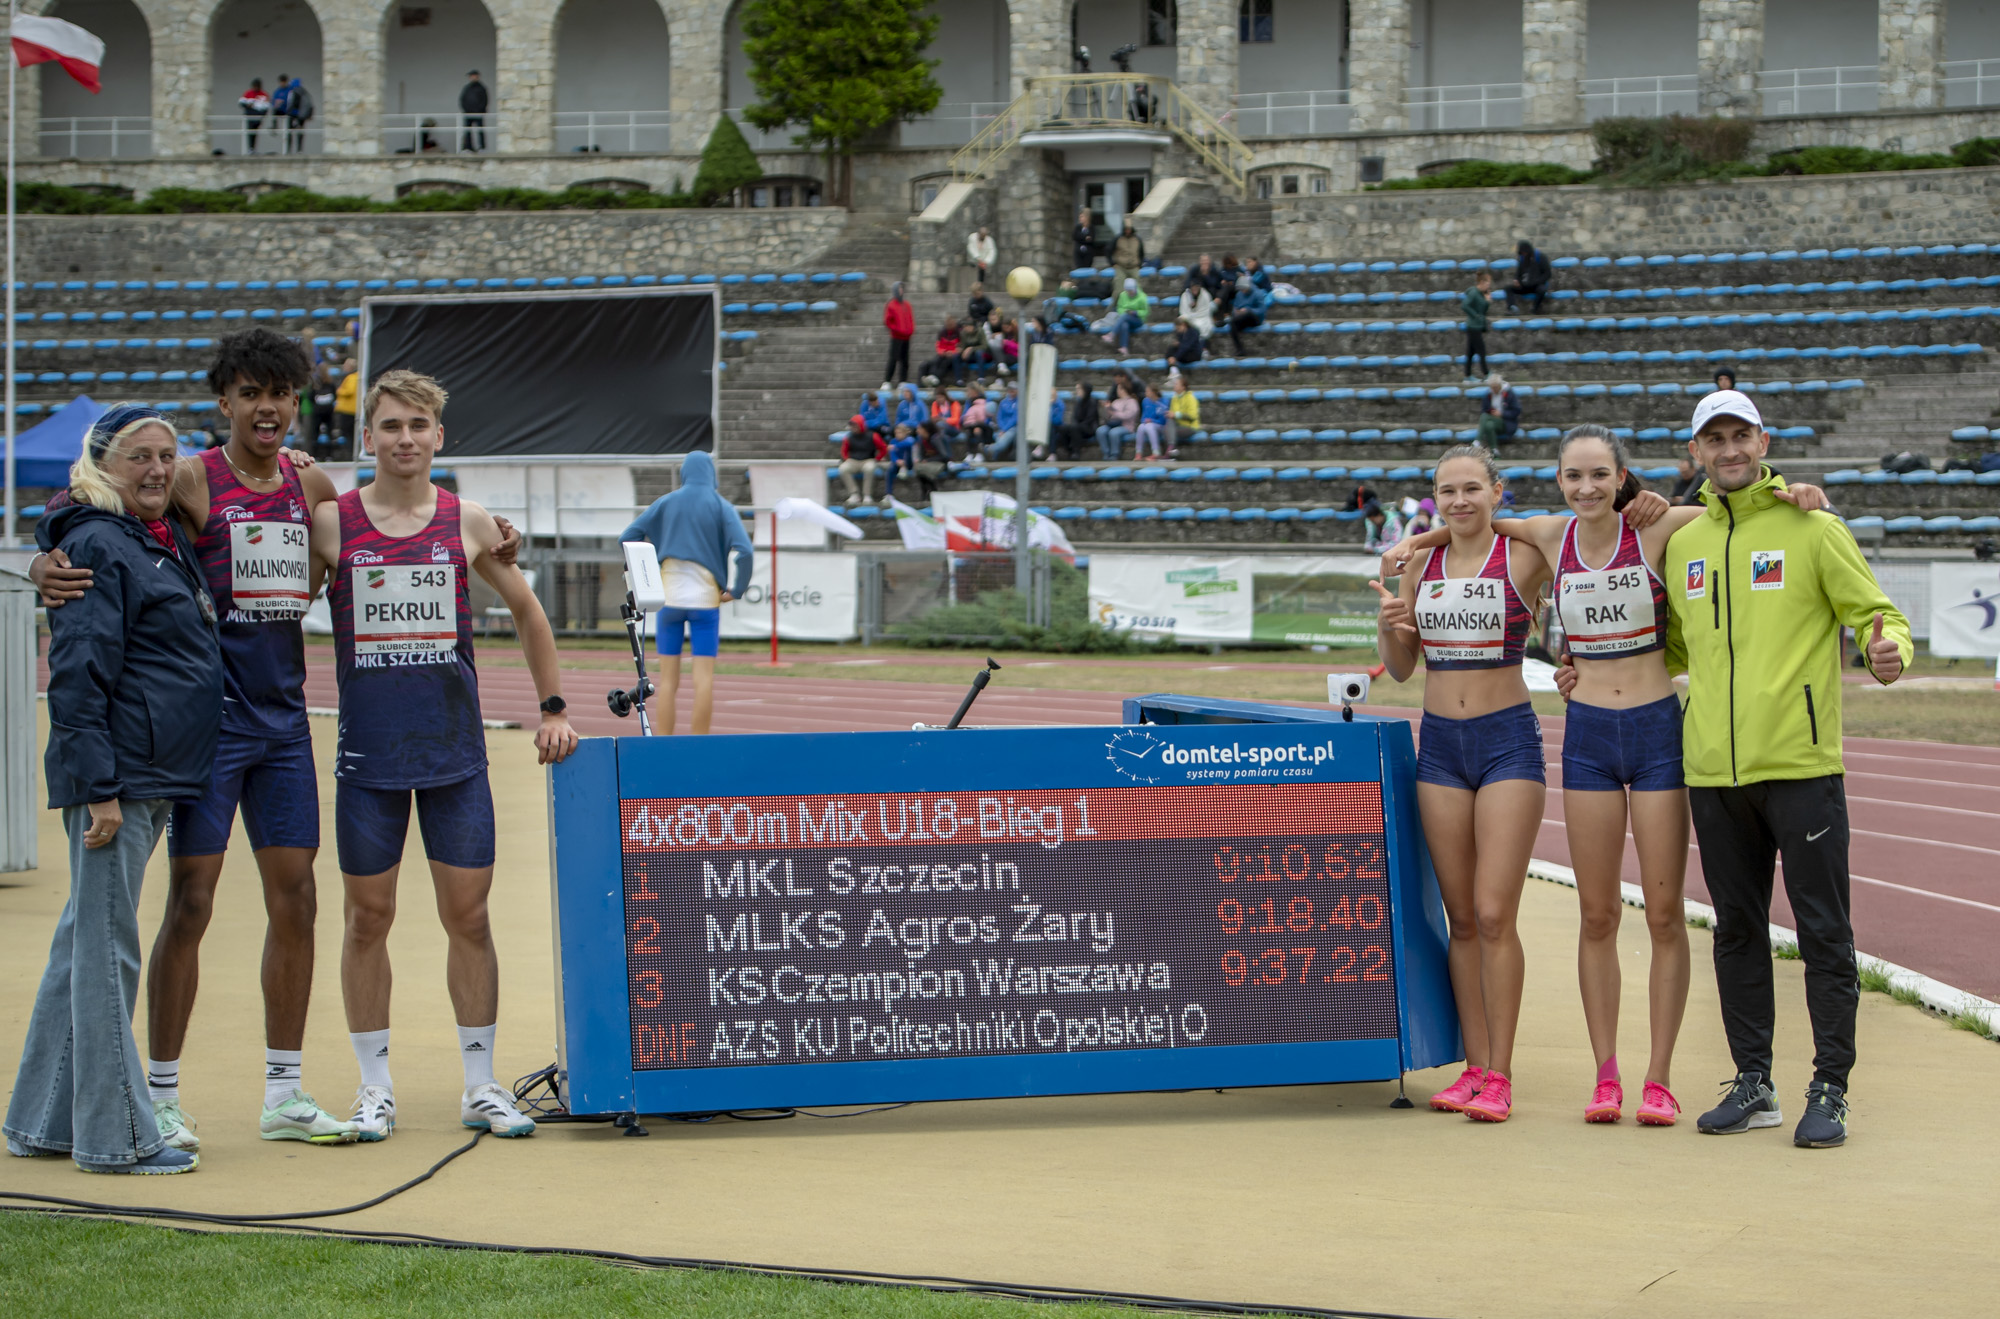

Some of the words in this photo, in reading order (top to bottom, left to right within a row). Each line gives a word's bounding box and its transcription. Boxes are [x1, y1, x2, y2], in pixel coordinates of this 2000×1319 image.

[225, 509, 254, 521] Enea
[282, 528, 305, 547] 542
[235, 559, 307, 580] MALINOWSKI
[353, 555, 384, 565] Enea
[411, 570, 447, 588] 543
[1607, 571, 1641, 591] 545
[1463, 583, 1497, 599] 541
[255, 600, 289, 608] SŁUBICE
[365, 601, 446, 622] PEKRUL
[226, 609, 258, 623] MKL
[1418, 608, 1502, 630] LEMAŃSKA
[1585, 603, 1628, 625] RAK
[377, 643, 413, 651] SŁUBICE
[414, 642, 436, 650] 2024
[1437, 649, 1462, 657] SŁUBICE
[1585, 642, 1617, 651] SŁUBICE
[1618, 640, 1638, 649] 2024
[355, 653, 386, 668] MKL
[388, 649, 458, 666] SZCZECIN
[1161, 740, 1335, 767] domtel-sport.pl
[1186, 770, 1231, 780] systemy
[1234, 767, 1280, 779] pomiaru
[1283, 767, 1313, 777] czasu
[628, 803, 788, 846] 4x800m
[799, 800, 869, 842] Mix
[879, 797, 1063, 849] U18-Bieg
[1074, 795, 1098, 835] 1
[703, 858, 813, 898] MKL
[828, 853, 1019, 894] Szczecin
[633, 916, 662, 954] 2
[705, 911, 846, 952] MLKS
[862, 908, 1000, 959] Agros
[1011, 894, 1115, 952] Żary
[1217, 894, 1384, 935] 9:18.40
[635, 970, 664, 1008] 3
[972, 957, 1171, 998] Warszawa
[1221, 945, 1389, 986] 9:37.22
[709, 1020, 781, 1060] AZS
[793, 1017, 839, 1057] KU
[849, 1009, 1026, 1055] Politechniki
[1033, 1004, 1175, 1053] Opolskiej
